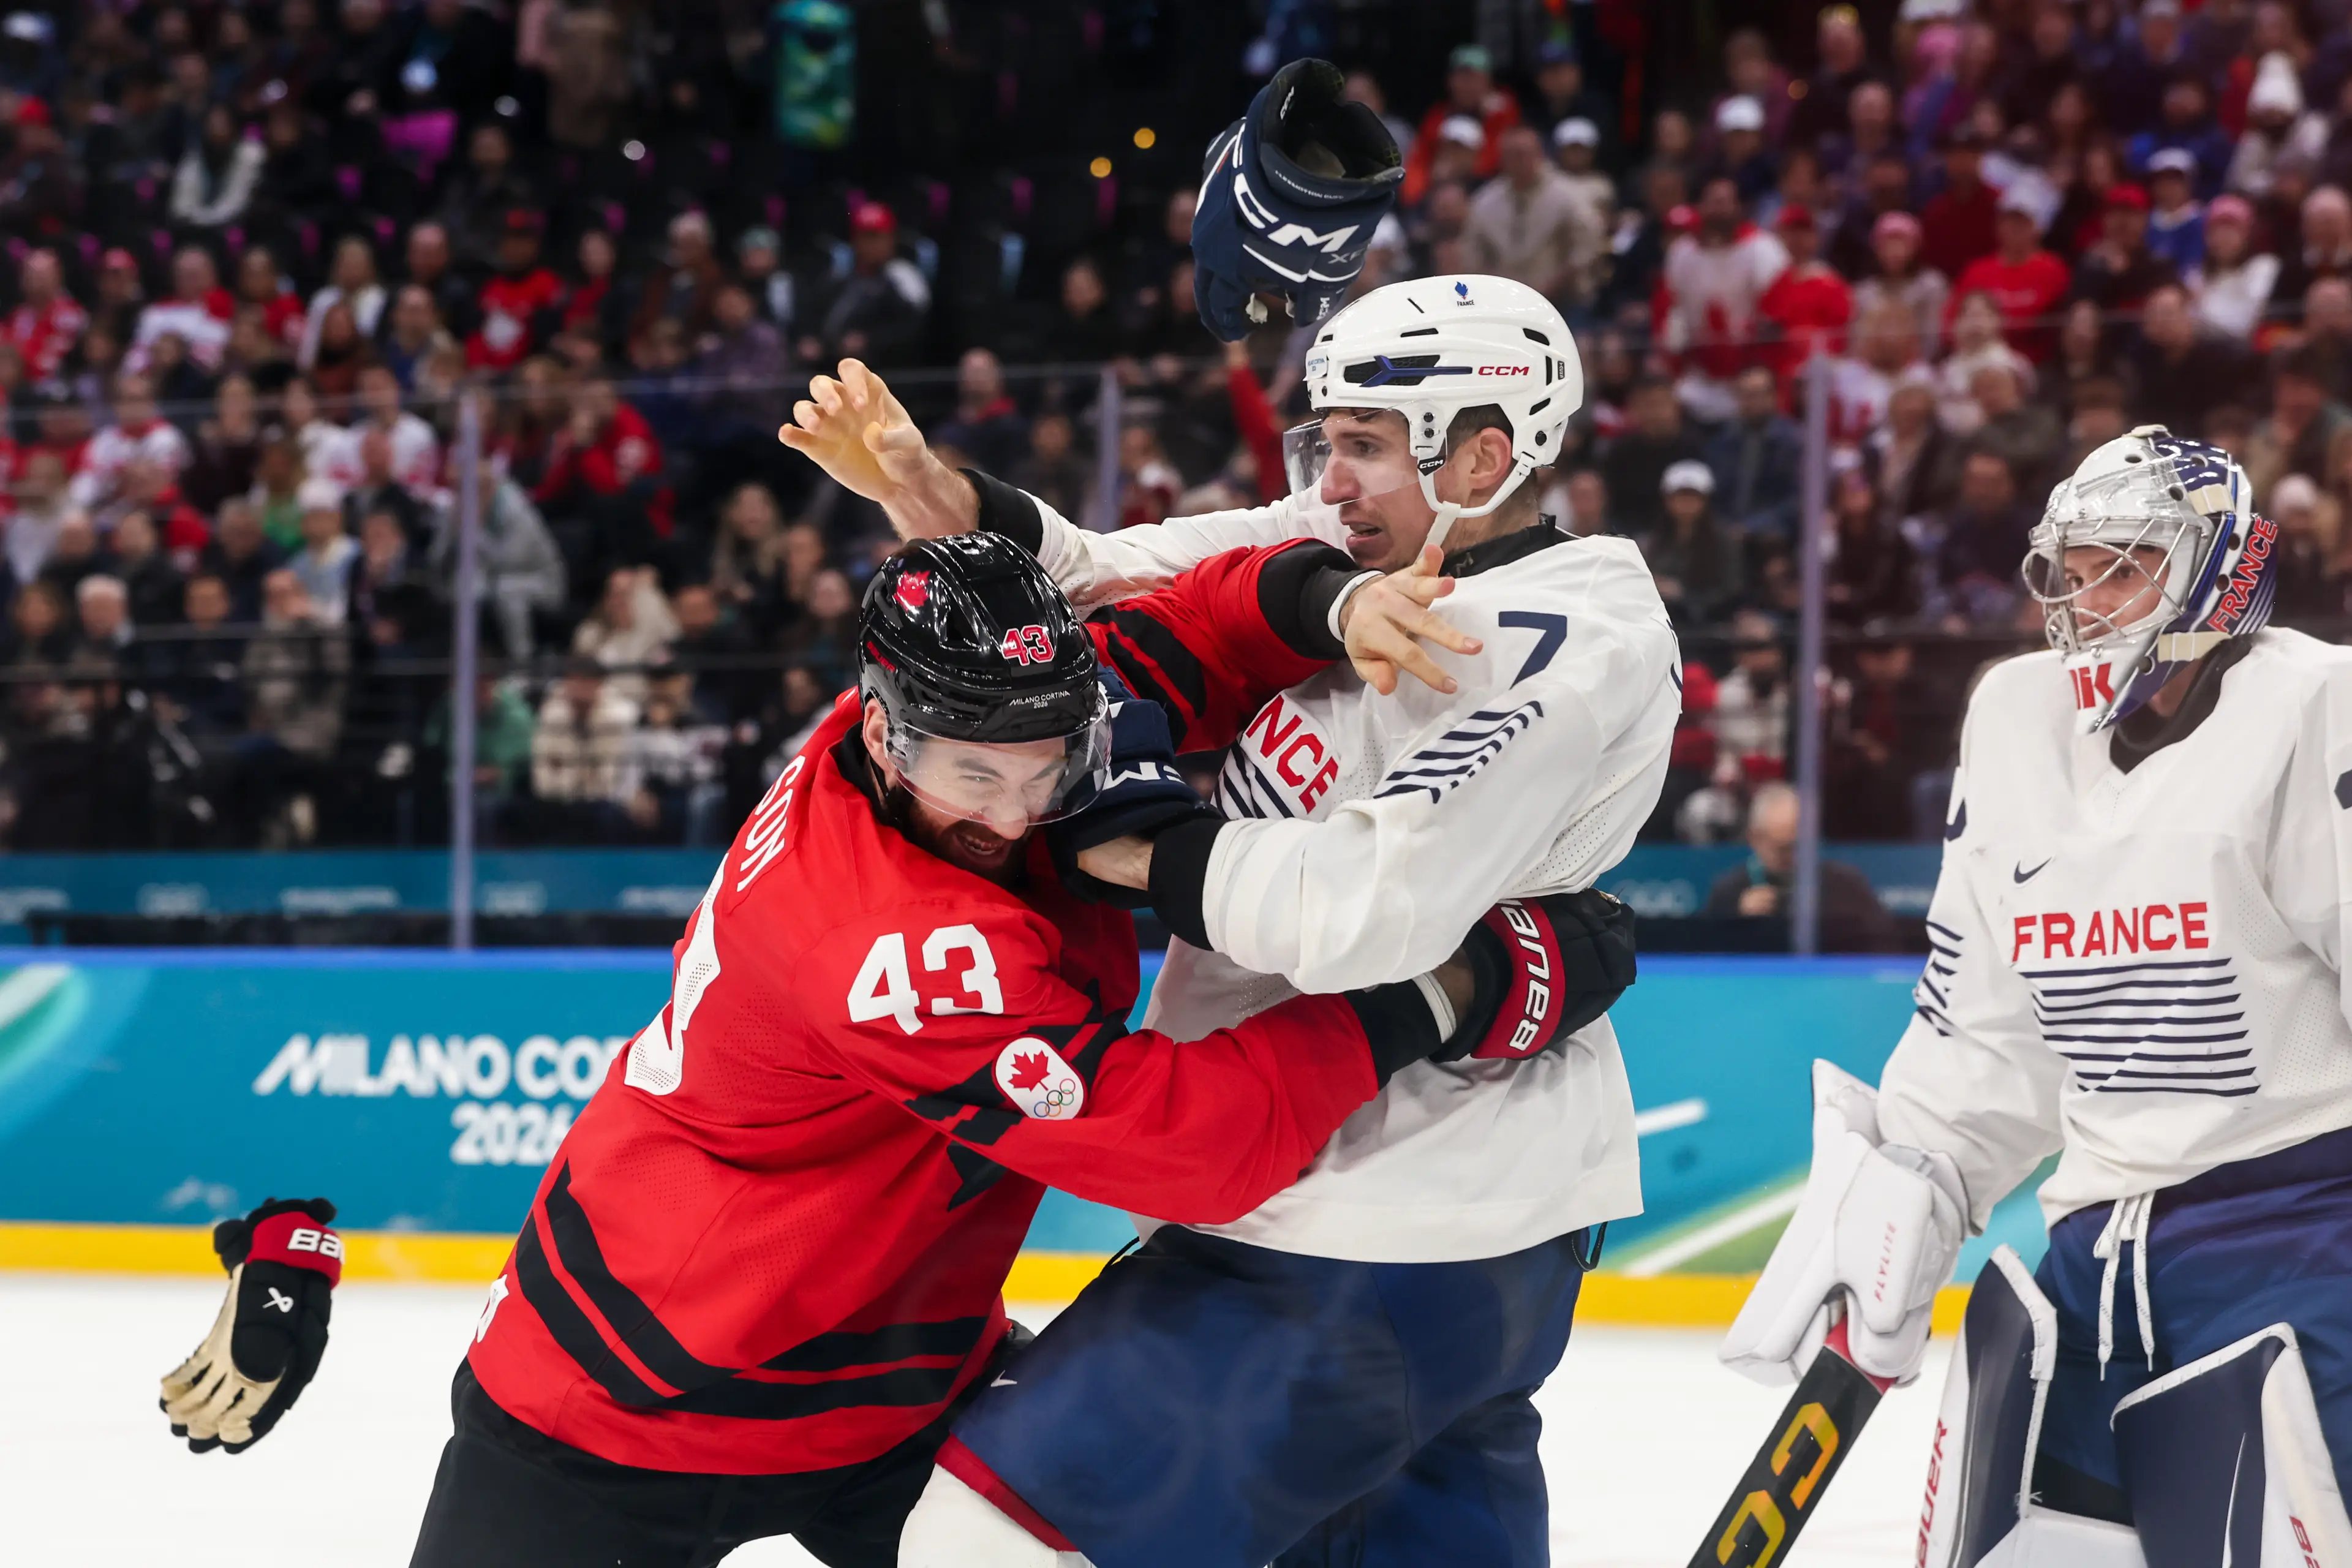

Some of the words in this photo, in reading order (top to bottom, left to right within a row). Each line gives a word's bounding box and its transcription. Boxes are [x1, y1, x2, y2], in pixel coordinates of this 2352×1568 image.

[1478, 366, 1530, 375] CCM
[1419, 459, 1444, 469] CCM
[2207, 516, 2278, 633] FRANCE
[1000, 625, 1054, 666] 43
[1498, 611, 1567, 690] 7
[1009, 695, 1040, 706] MILANO
[1041, 690, 1071, 701] CORTINA
[2012, 902, 2209, 961] FRANCE
[846, 923, 1004, 1036] 43
[252, 1033, 511, 1096] MILANO
[450, 1101, 575, 1166] 2026
[1915, 1417, 1947, 1568] AUER
